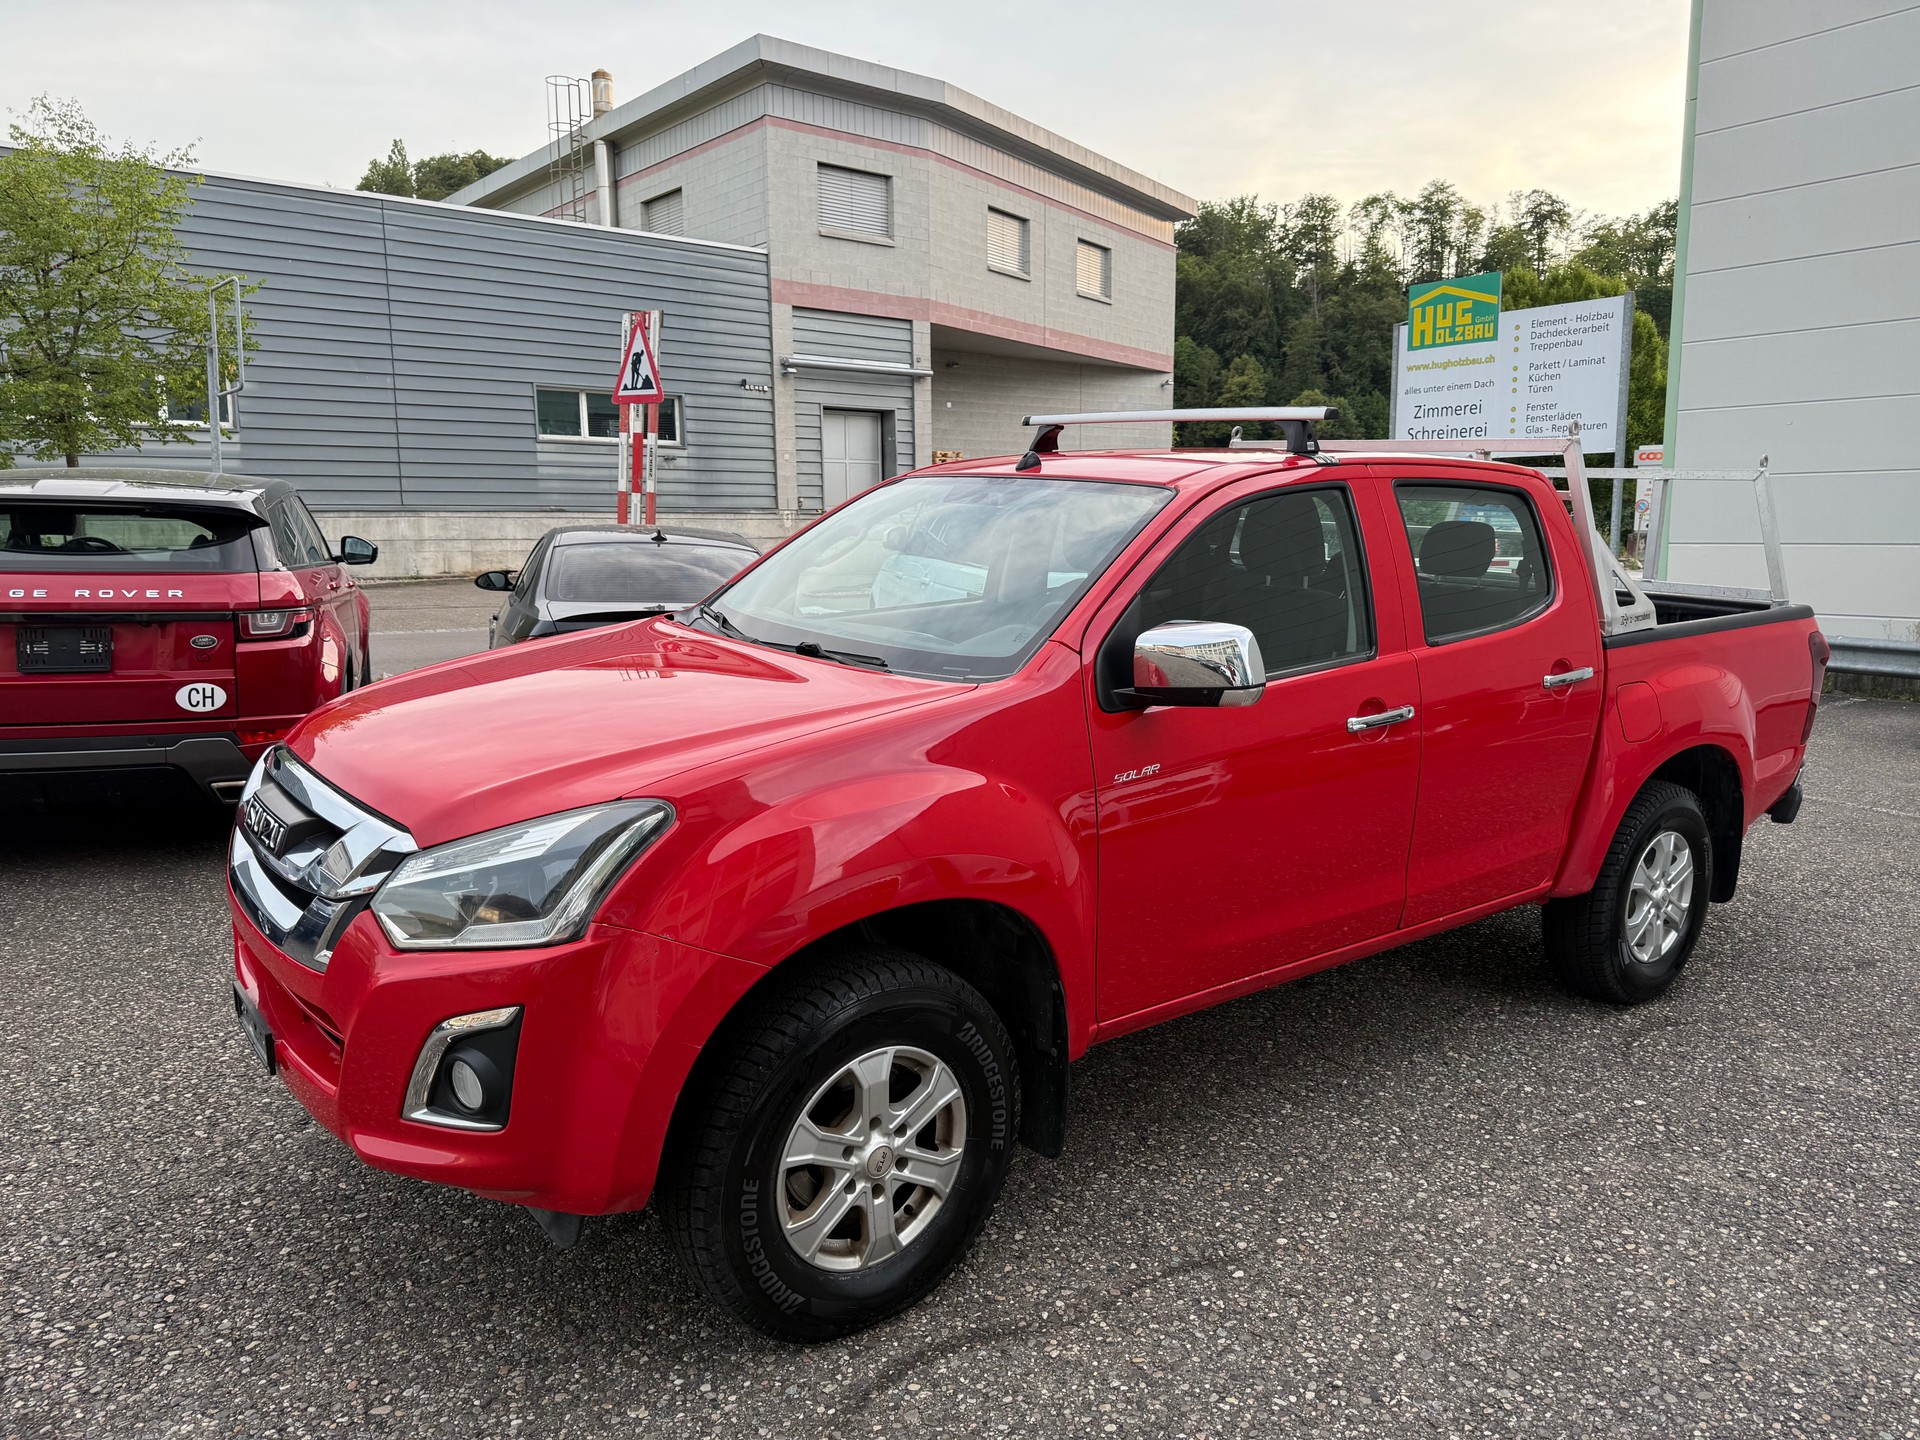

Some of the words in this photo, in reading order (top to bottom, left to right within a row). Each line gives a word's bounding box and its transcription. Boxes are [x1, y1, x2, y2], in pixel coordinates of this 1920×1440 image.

[1412, 299, 1472, 346] HUG
[1474, 314, 1495, 323] GmbH
[1531, 317, 1567, 329] Element
[1575, 311, 1614, 323] Holzbau
[1530, 322, 1610, 340] Dachdeckerarbeit
[1530, 339, 1583, 352] Treppenbau
[1406, 354, 1496, 372] www.hugholzbau.ch
[1529, 361, 1561, 371] Parkett
[1568, 356, 1606, 368] Laminat
[1528, 372, 1561, 383] Küchen
[1404, 386, 1422, 395] alles
[1423, 385, 1445, 394] unter
[1446, 382, 1472, 391] einem
[1473, 379, 1495, 389] Dach
[1528, 384, 1553, 394] Türen
[1413, 399, 1482, 420] Zimmerei
[1526, 402, 1558, 412] Fenster
[1526, 411, 1582, 423] Fensterläden
[1407, 421, 1488, 440] Schreinerei
[1525, 425, 1544, 434] Glas
[1551, 422, 1608, 433] Repaturen
[1638, 452, 1664, 461] coo
[74, 589, 184, 598] ROVER
[187, 687, 216, 708] CH
[1113, 763, 1161, 784] SOLAR
[245, 797, 286, 855] ISUZU
[955, 1021, 1008, 1150] BRIDGESTONE
[739, 1177, 806, 1315] BRIDGESTONE
